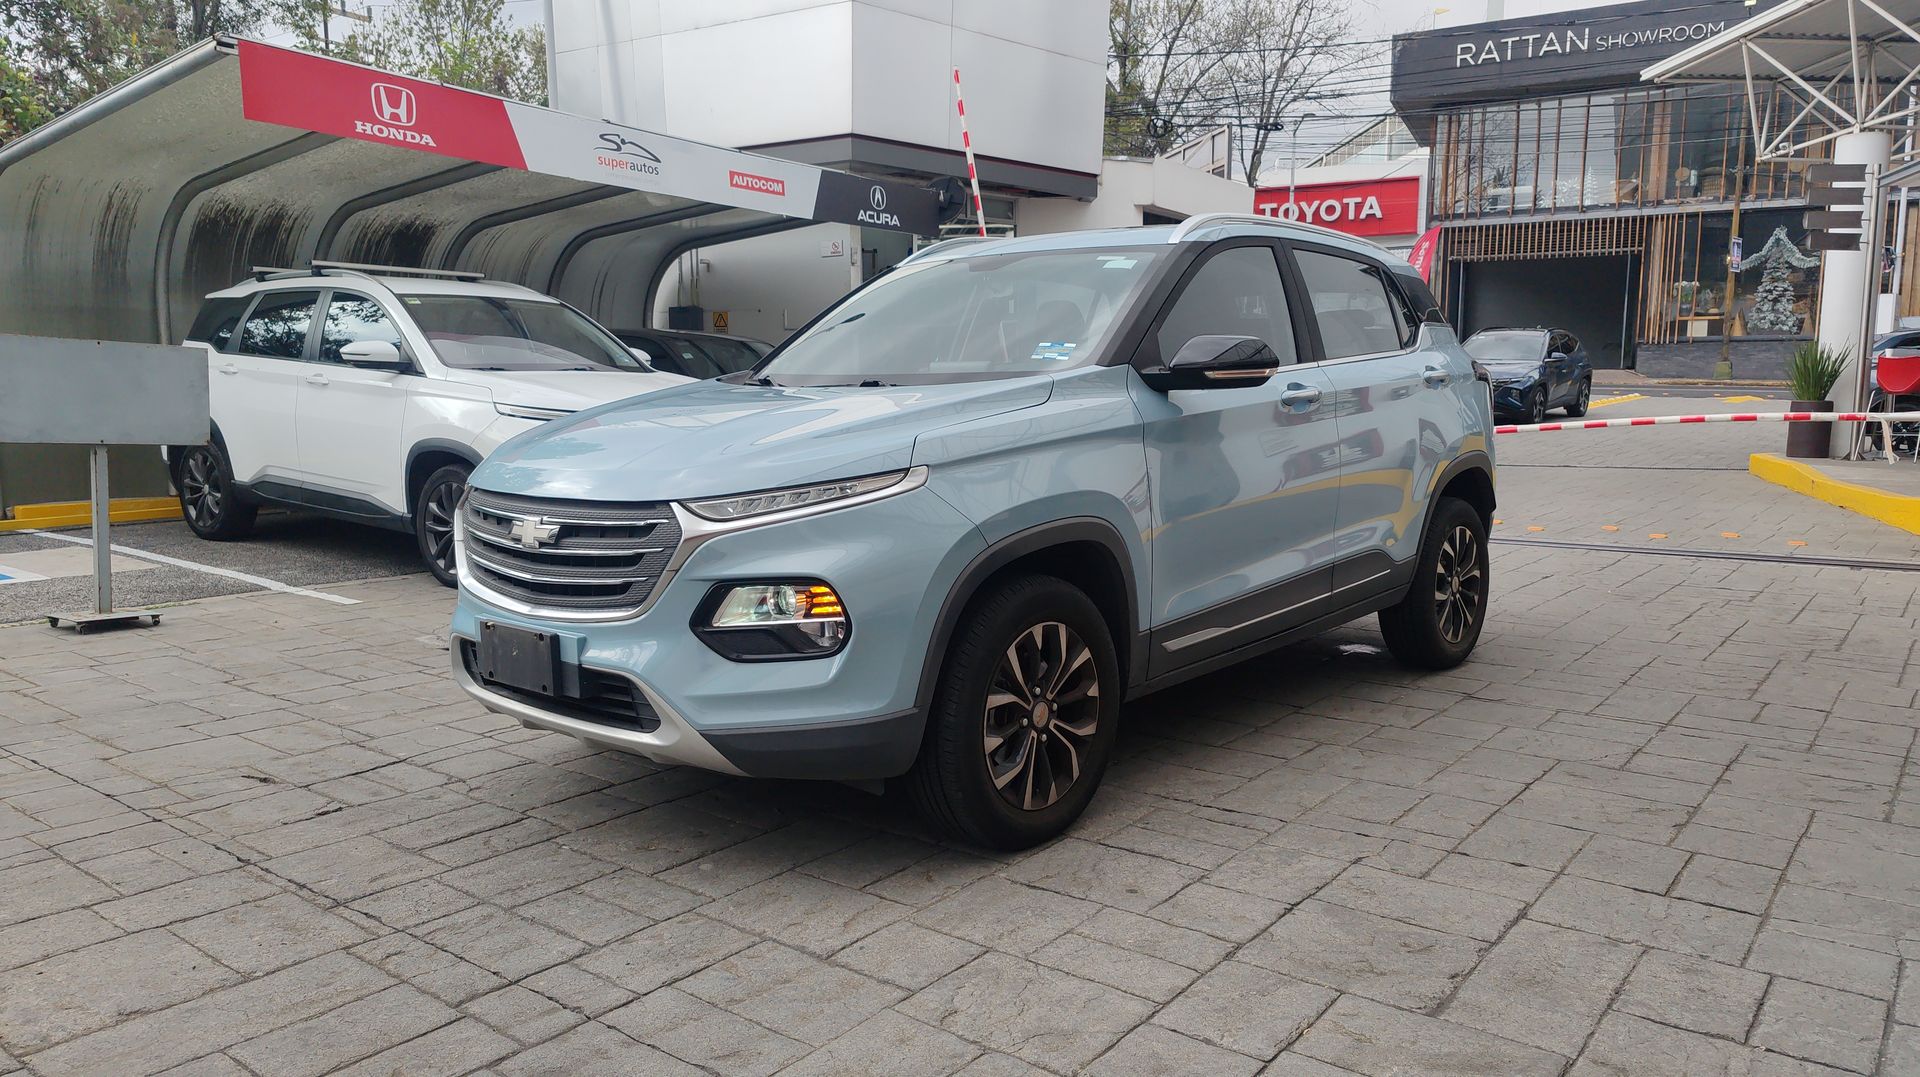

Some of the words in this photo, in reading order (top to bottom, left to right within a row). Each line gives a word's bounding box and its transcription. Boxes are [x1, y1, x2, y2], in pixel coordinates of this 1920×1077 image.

[1456, 28, 1589, 68] RATTAN
[1596, 21, 1725, 51] SHOWROOM
[354, 120, 437, 147] HONDA
[597, 155, 660, 176] superautos
[732, 175, 783, 193] AUTOCOM
[857, 209, 900, 226] ACURA
[1259, 196, 1383, 223] TOYOTA
